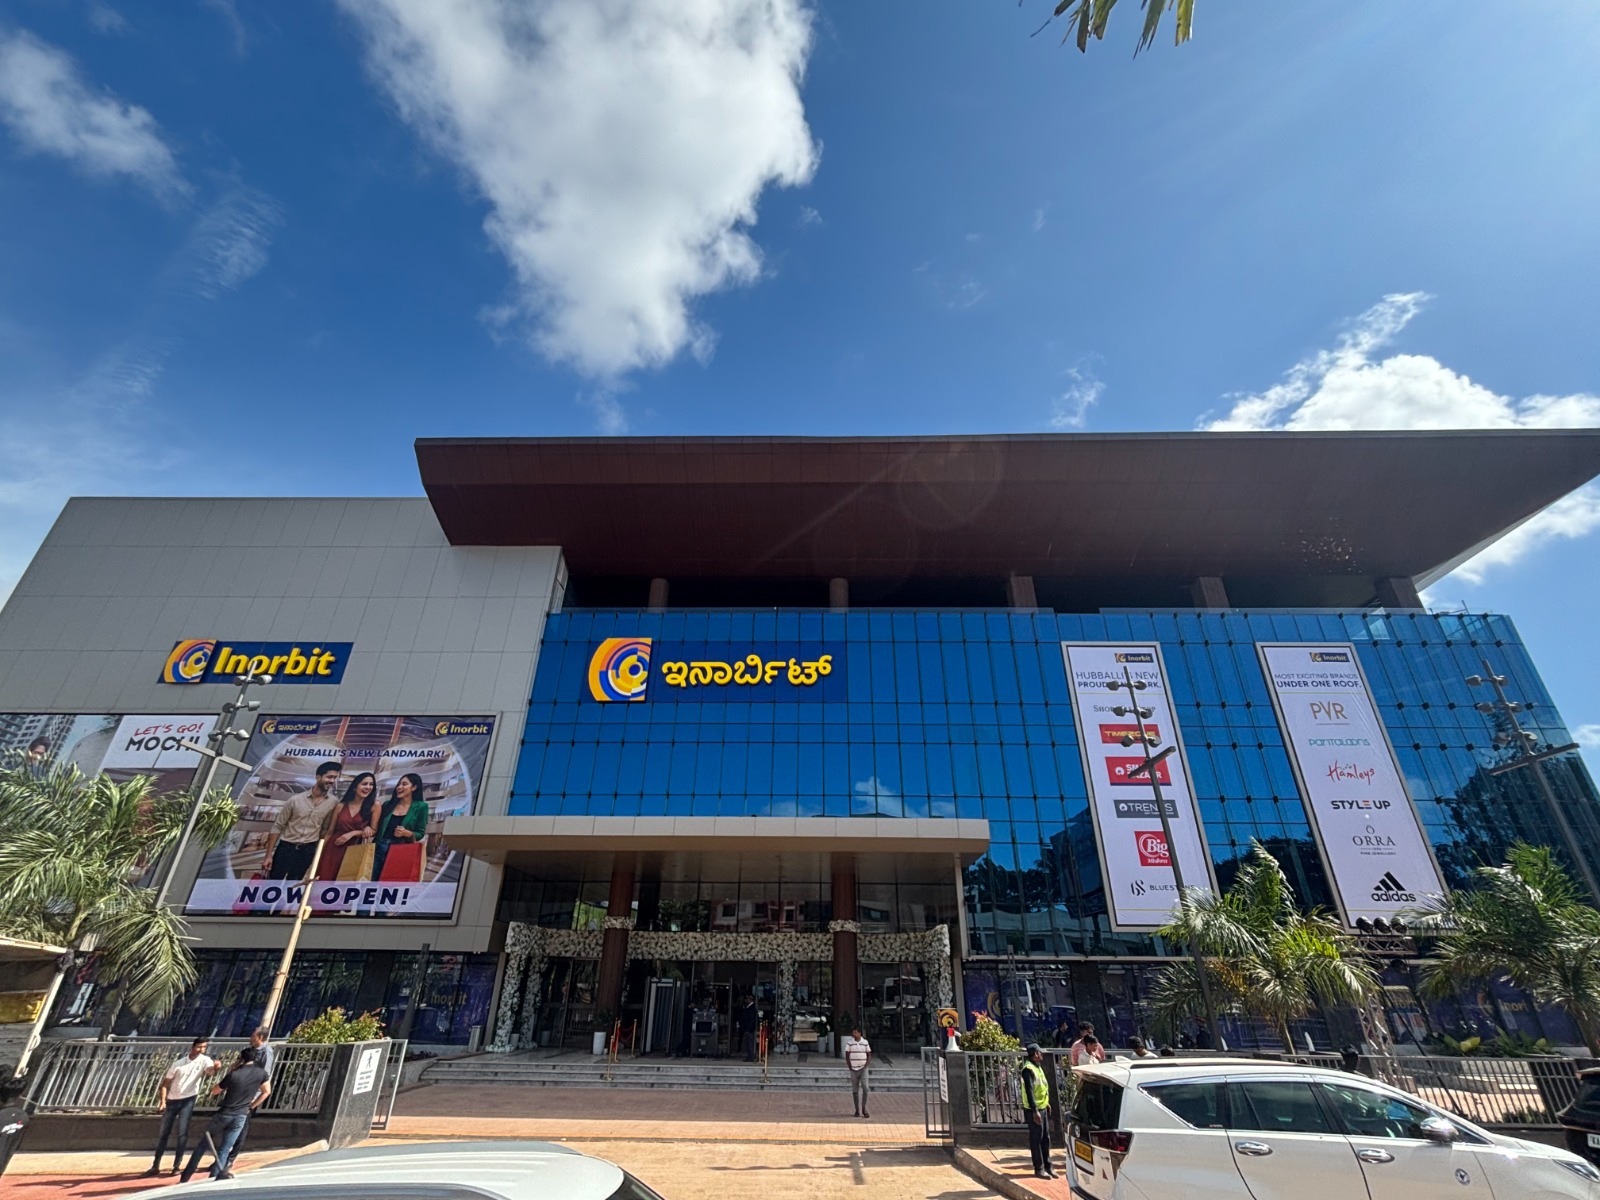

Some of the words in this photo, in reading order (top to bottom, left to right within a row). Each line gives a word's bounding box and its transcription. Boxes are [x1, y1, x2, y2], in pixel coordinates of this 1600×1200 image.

[213, 647, 336, 675] Inorbit
[661, 654, 832, 687] ಇನಾರ್ಬಿಟ್
[1135, 671, 1159, 680] NEW
[1277, 680, 1309, 688] UNDER
[1311, 680, 1332, 688] ONE
[1334, 680, 1362, 688] ROOF.
[1310, 701, 1348, 721] PVR
[134, 724, 173, 736] LET'S
[177, 722, 204, 733] GO!
[450, 725, 488, 733] Inorbit
[285, 748, 347, 757] HUBBALLI'S
[348, 749, 374, 757] NEW
[376, 749, 444, 758] LANDMARK!
[1327, 760, 1375, 785] Hamleys
[1127, 802, 1173, 811] TRENS
[1146, 838, 1169, 857] Big
[1353, 836, 1396, 846] ORRA
[320, 887, 410, 905] OPEN!
[1371, 890, 1417, 902] adidas
